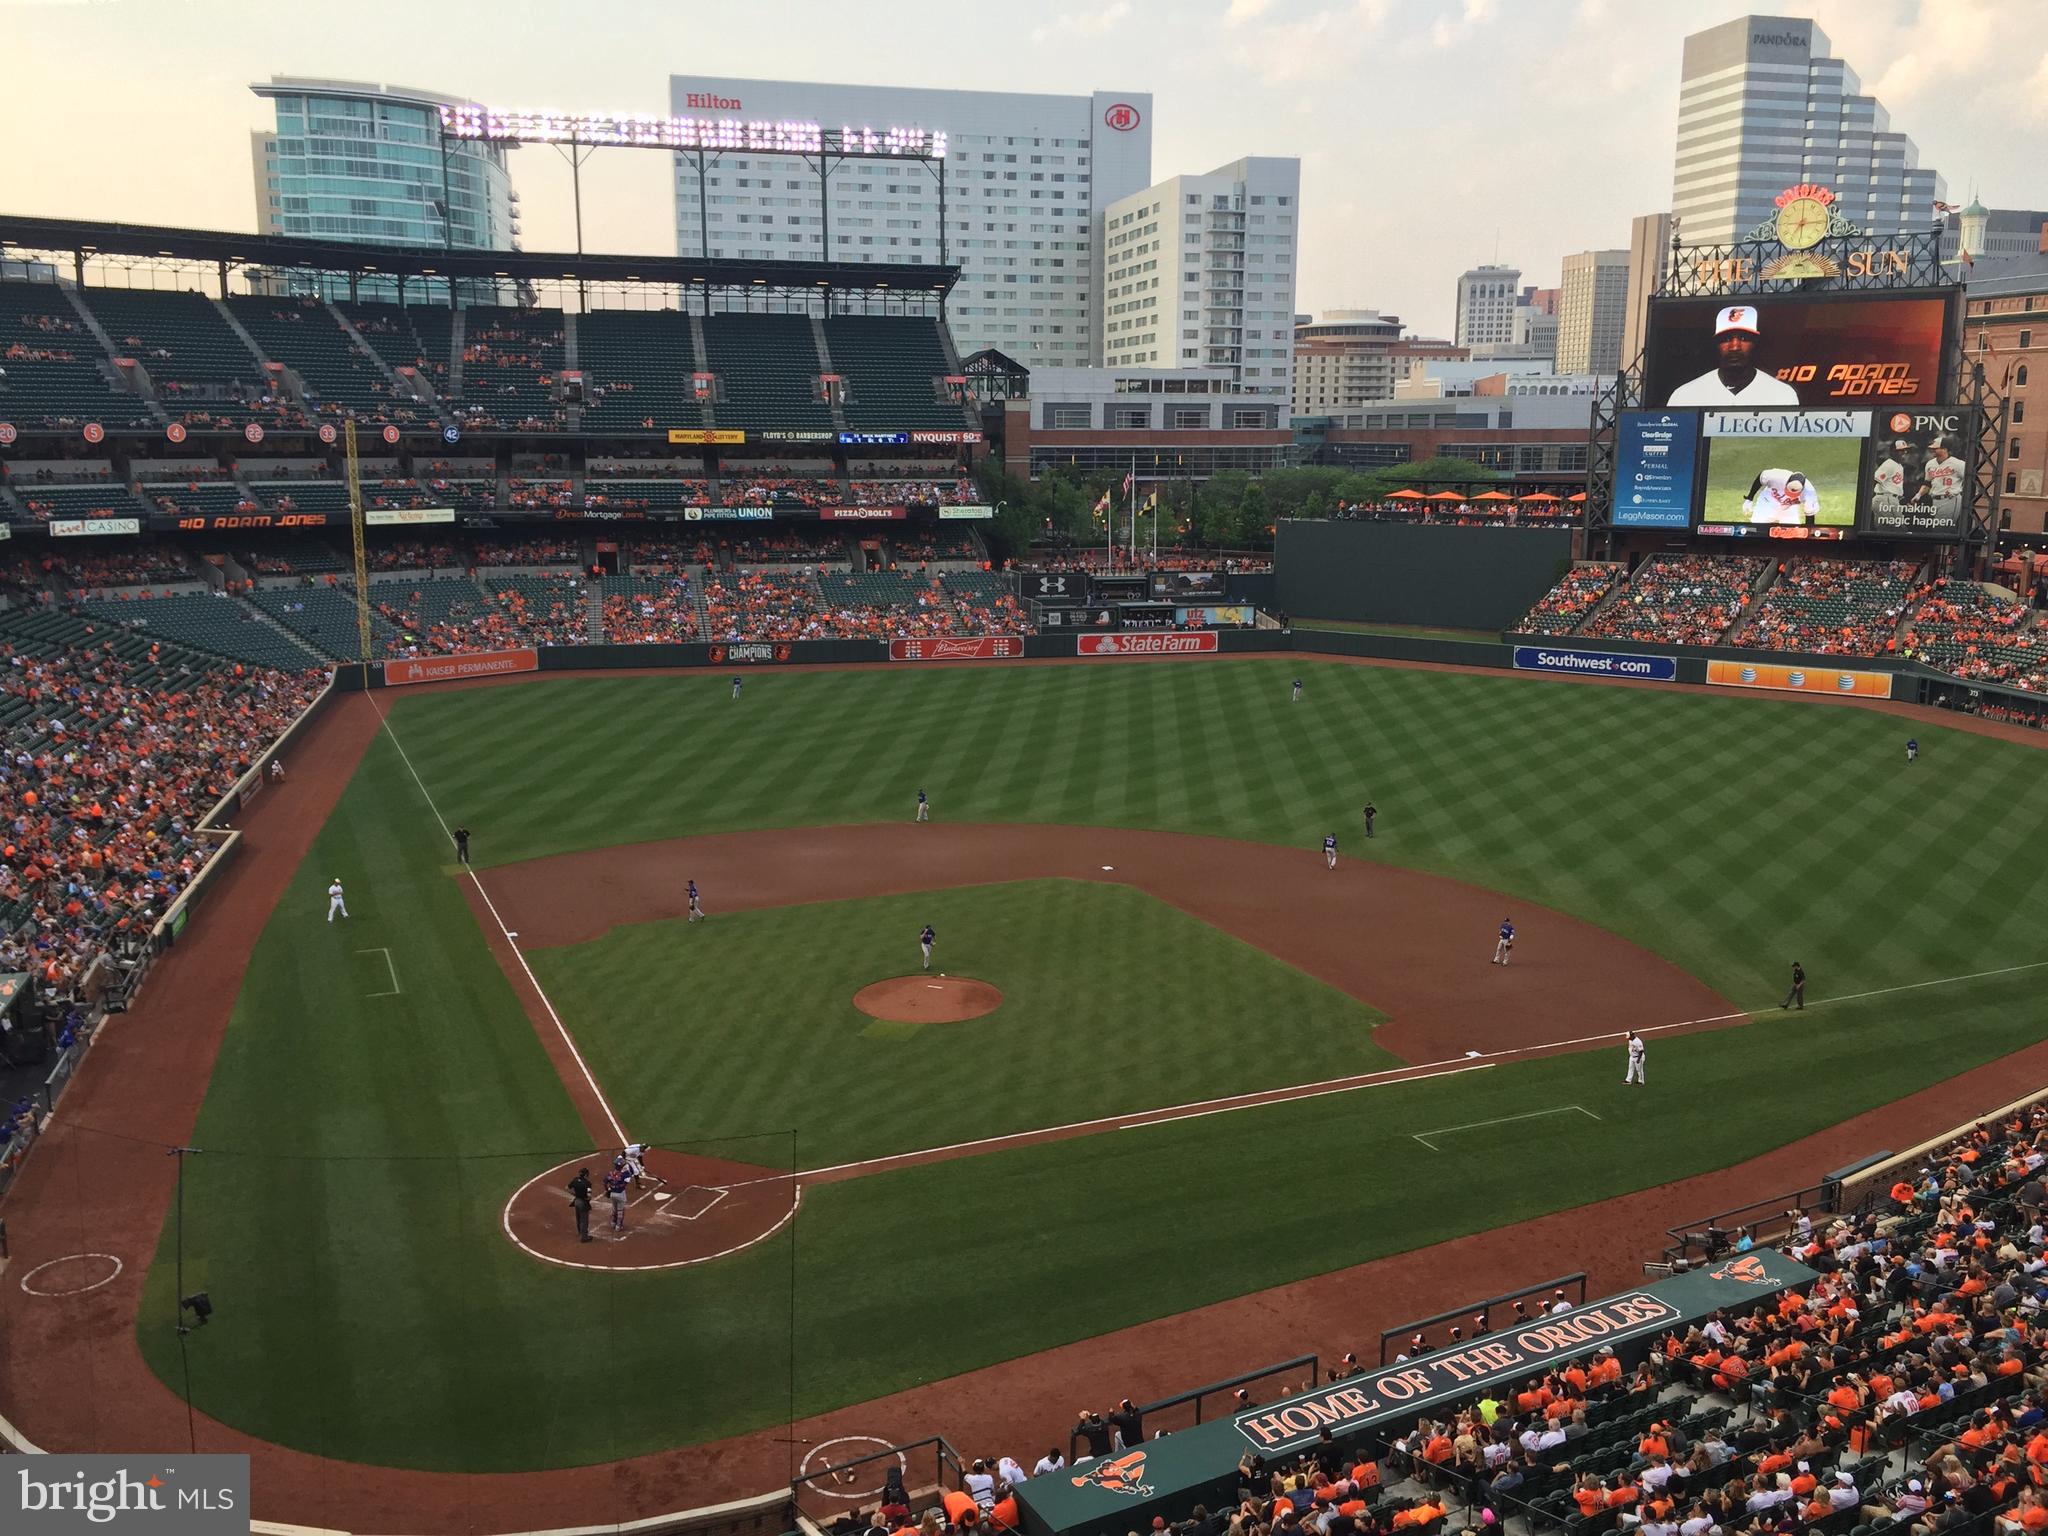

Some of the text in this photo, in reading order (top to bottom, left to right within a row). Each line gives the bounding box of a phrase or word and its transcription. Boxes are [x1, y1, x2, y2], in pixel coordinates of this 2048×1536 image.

[1753, 33, 1807, 47] PANDORA
[686, 93, 742, 110] Hilton
[1695, 250, 1910, 284] THE SUN
[1776, 363, 1911, 382] #10 ADAM
[1719, 415, 1854, 433] LEGG MASON
[1914, 415, 1959, 431] PNC
[0, 427, 12, 439] 20
[91, 427, 98, 438] 5
[173, 427, 179, 439] 4
[248, 427, 261, 439] 22
[322, 428, 334, 439] 33
[389, 428, 395, 440] 8
[446, 429, 457, 440] 42
[796, 432, 833, 440] BARBERSHOP
[963, 432, 975, 440] 60
[738, 507, 773, 518] UNION
[1879, 502, 1937, 516] for making
[178, 514, 327, 529] #10 ADAM JONES
[1618, 511, 1685, 522] LeggMason.com
[1877, 515, 1956, 529] magic happen.
[87, 520, 138, 533] CASINO
[1741, 527, 1747, 535] 0
[729, 647, 772, 660] CHAMPIONS
[937, 641, 979, 653] Budweiser
[426, 659, 514, 677] KAISER PERMANENTE
[1245, 1294, 1668, 1444] HOME OF THE ORIOLES
[1907, 1399, 1918, 1413] 10
